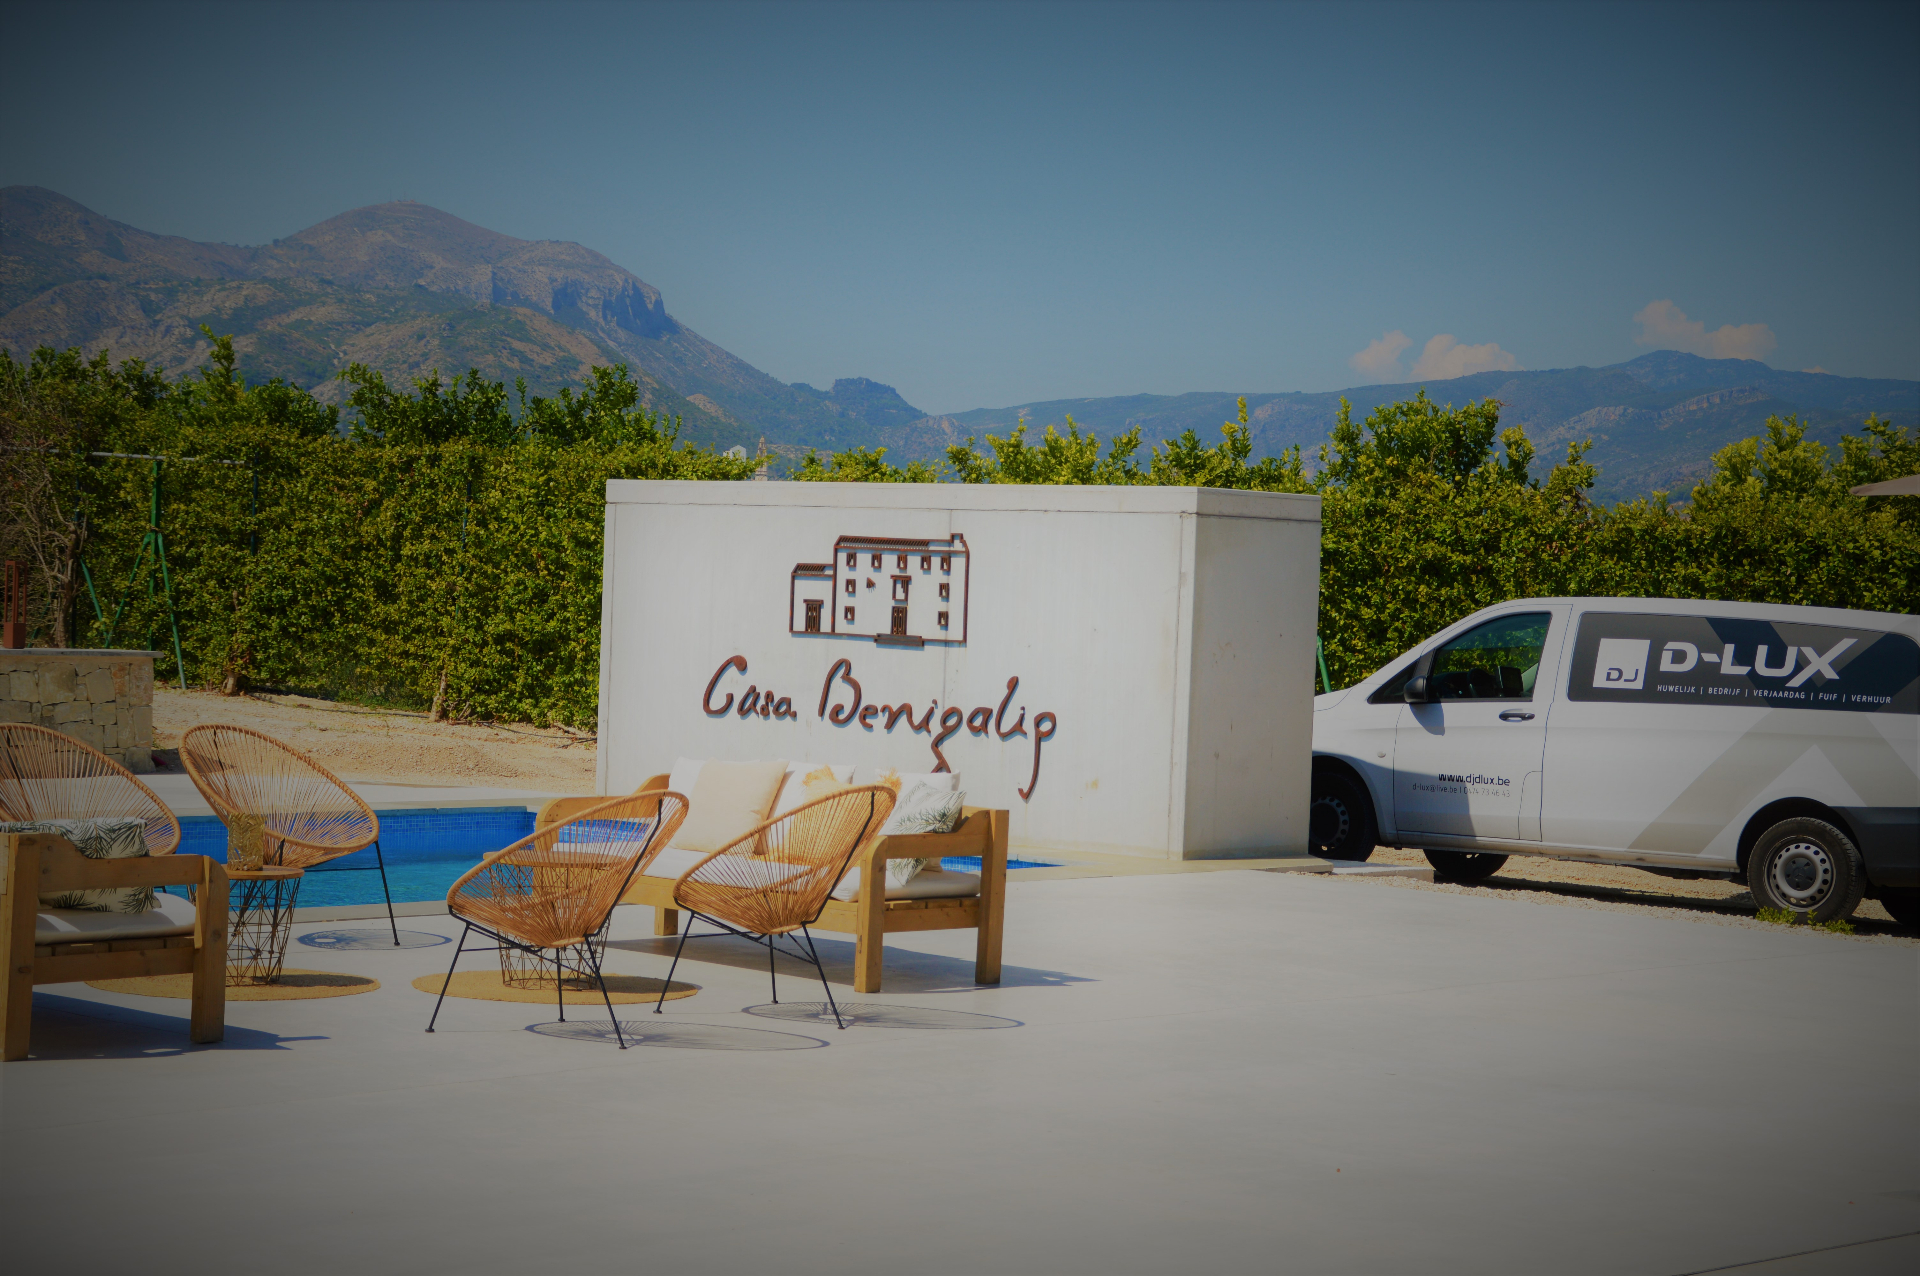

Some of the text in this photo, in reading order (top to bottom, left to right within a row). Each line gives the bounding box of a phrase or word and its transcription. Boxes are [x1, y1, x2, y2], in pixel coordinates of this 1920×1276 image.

[1605, 637, 1859, 688] DJ D-LUX
[1656, 684, 1892, 704] HUWELIJK BEDRIJF VERJAARDAG FUIF VERHUUR
[702, 655, 1057, 800] Casa Benigalip
[1438, 773, 1511, 786] www.djdlux.be
